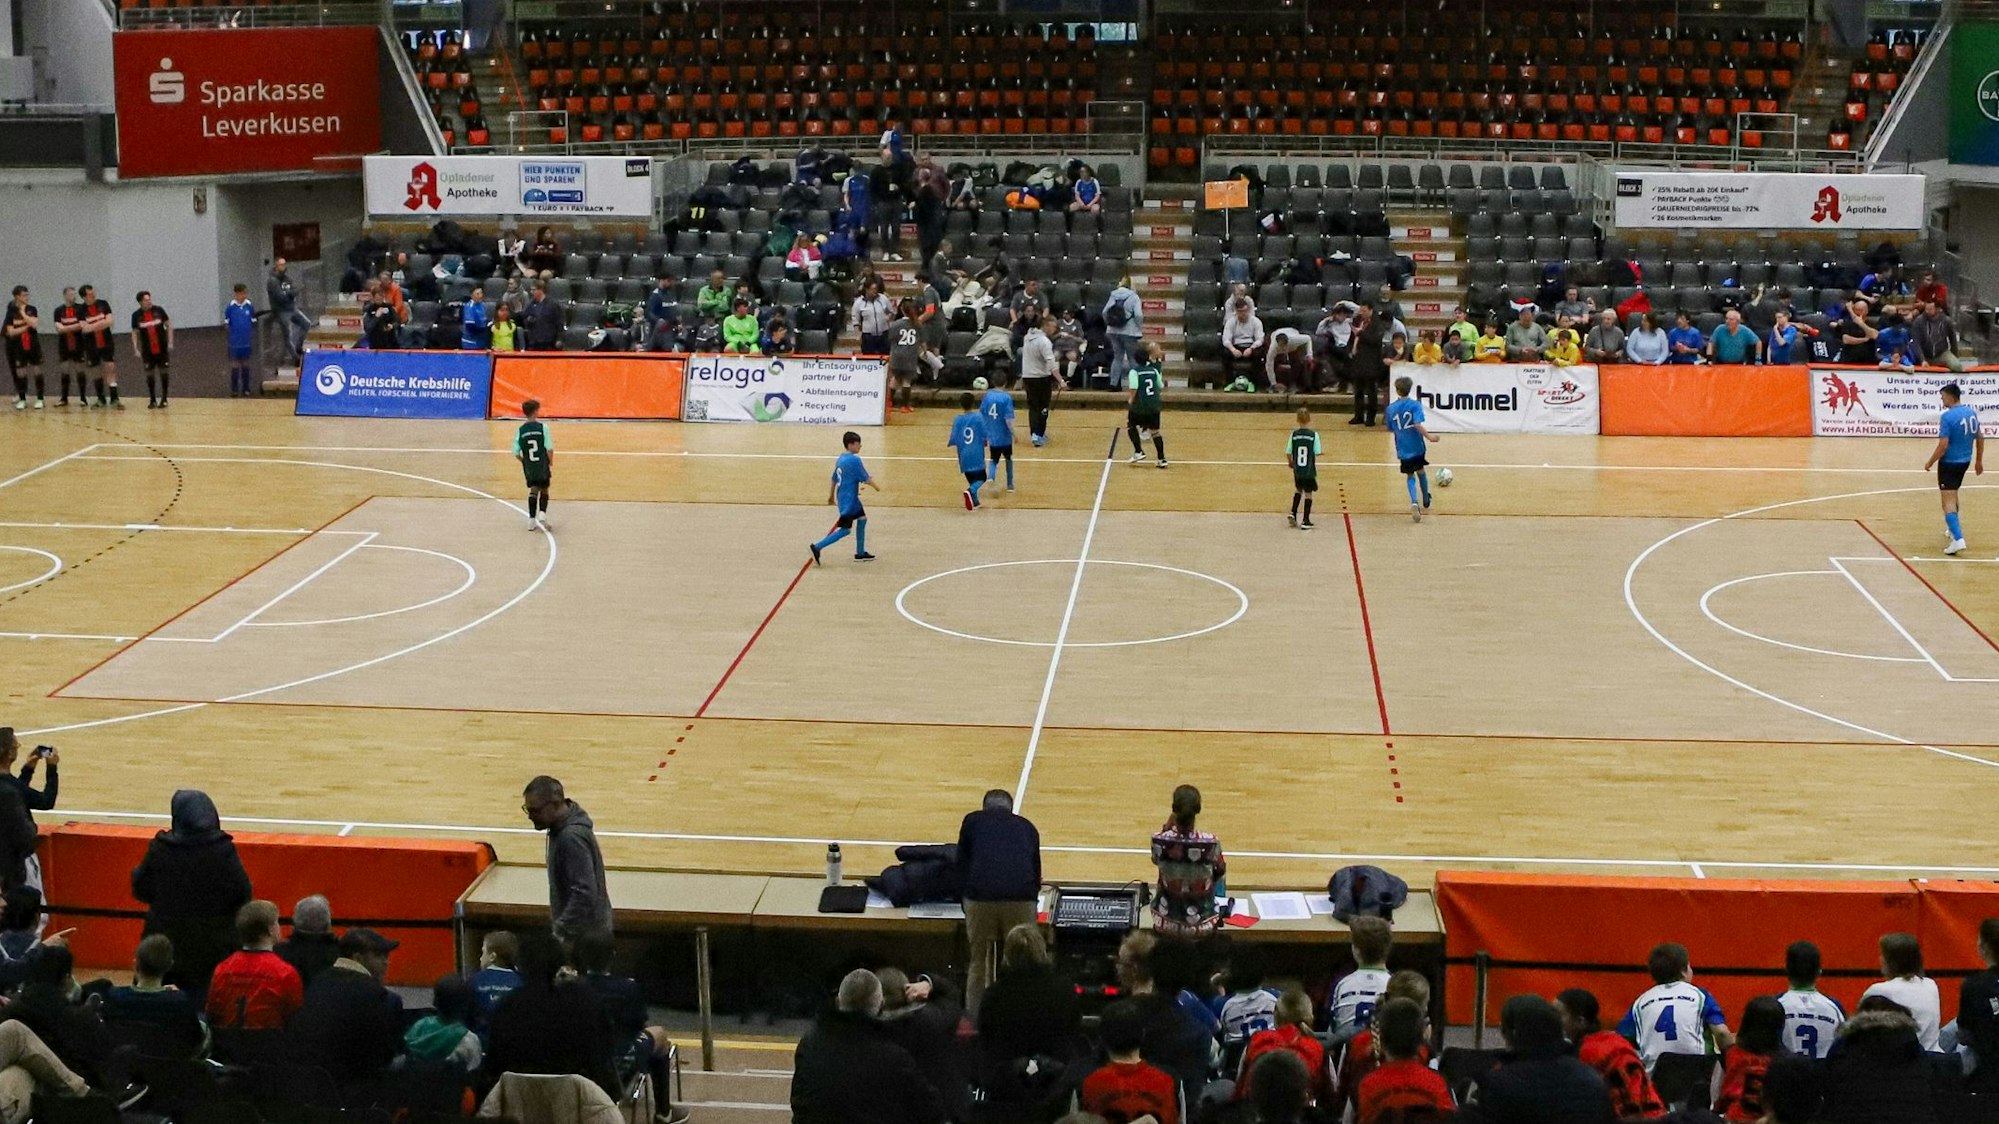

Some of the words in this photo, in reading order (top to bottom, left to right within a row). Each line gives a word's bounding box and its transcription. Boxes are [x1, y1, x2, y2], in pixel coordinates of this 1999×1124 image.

[200, 79, 325, 108] Sparkasse
[1982, 90, 1999, 100] BA
[202, 112, 340, 137] Leverkusen
[524, 165, 542, 174] HIER
[545, 165, 580, 174] PUNKTEN
[627, 164, 643, 173] BLOCK
[644, 164, 649, 172] 4
[440, 172, 494, 185] Opladener
[524, 175, 541, 183] UND
[544, 175, 575, 183] SPAREN!
[447, 187, 498, 199] Apotheke
[1846, 205, 1887, 215] Apotheke
[898, 328, 917, 346] 26
[803, 361, 816, 369] Ihr
[818, 362, 883, 372] Entsorgungs-
[689, 359, 766, 389] reloga
[802, 373, 836, 382] partner
[838, 373, 852, 382] für
[350, 376, 406, 388] Deutsche
[408, 377, 472, 391] Krebshilfe
[1145, 378, 1155, 396] 2
[1923, 378, 1958, 387] Jugend
[349, 389, 377, 397] HELFEN.
[378, 389, 418, 398] FORSCHEN.
[419, 391, 471, 399] INFORMIEREN.
[806, 387, 879, 398] Abfallentsorgung
[1416, 384, 1518, 411] hummel
[1876, 387, 1900, 395] auch
[804, 402, 846, 412] Recycling
[988, 402, 999, 420] 4
[1882, 402, 1919, 410] Werden
[803, 416, 838, 424] Logistik
[1392, 411, 1414, 430] 12
[1960, 415, 1978, 436] 10
[963, 426, 974, 445] 9
[527, 439, 540, 462] 2
[1297, 446, 1308, 467] 8
[1654, 1005, 1678, 1041] 4
[1796, 1025, 1818, 1060] 3
